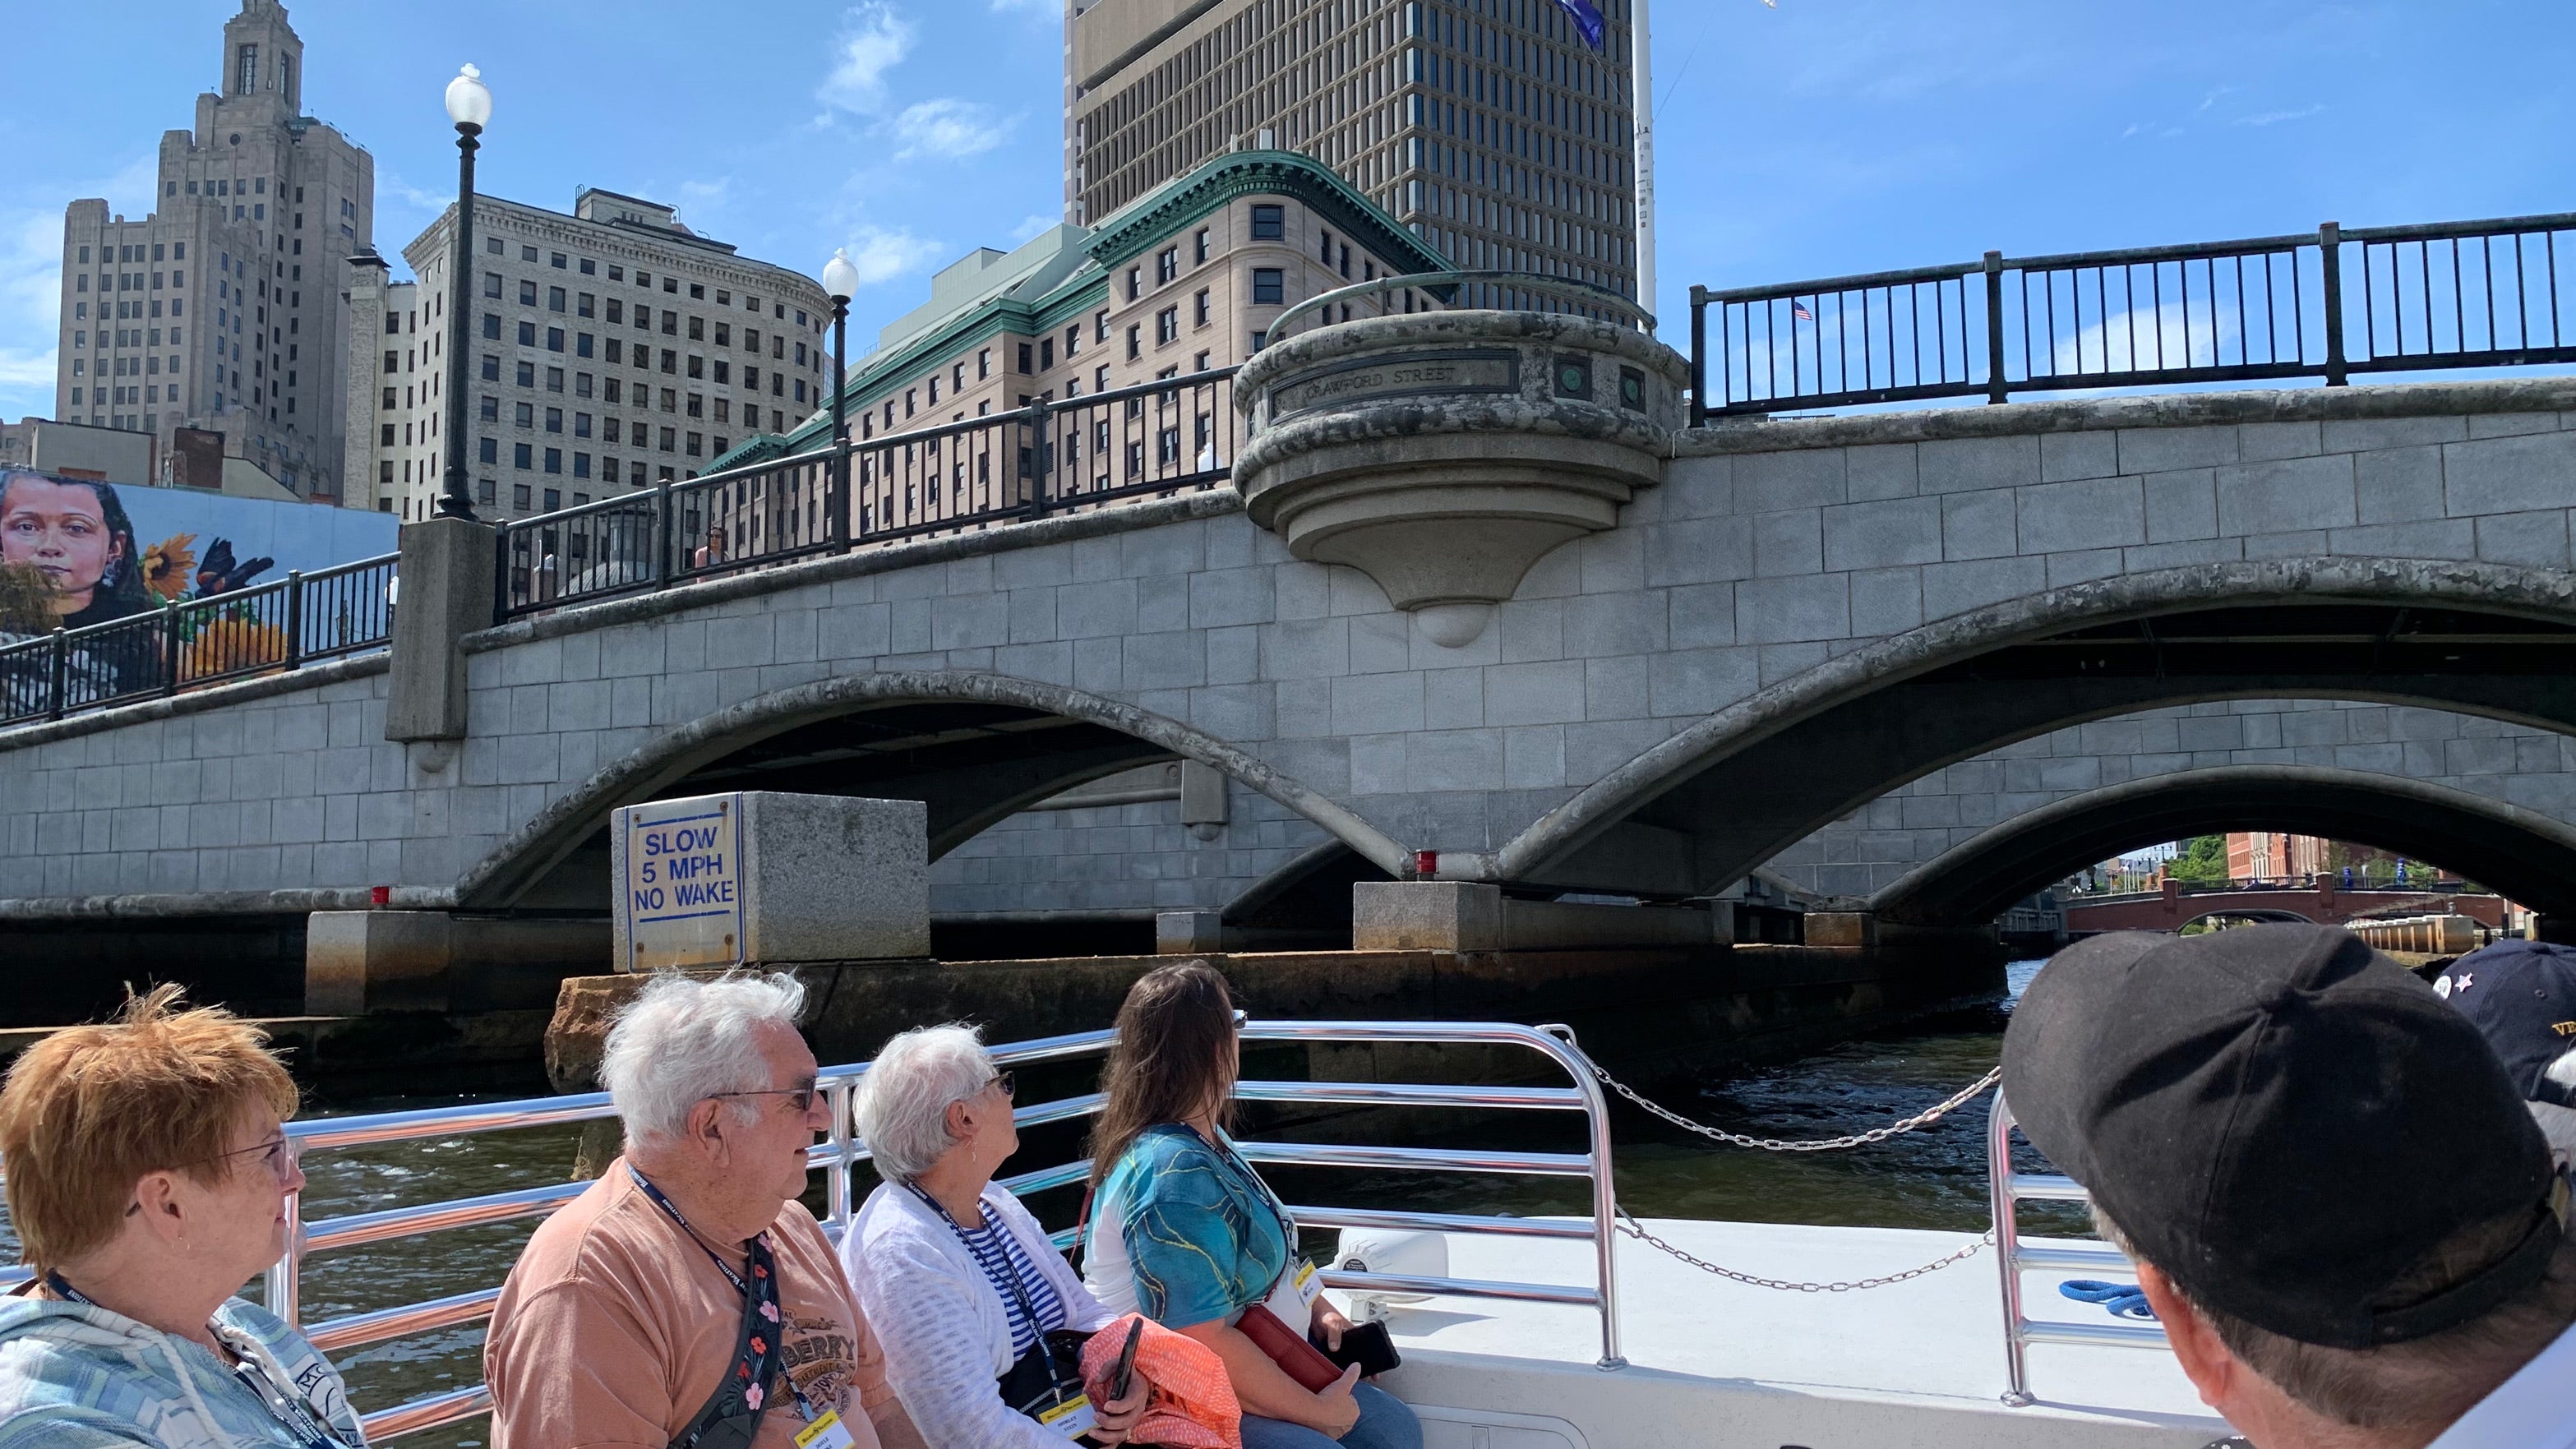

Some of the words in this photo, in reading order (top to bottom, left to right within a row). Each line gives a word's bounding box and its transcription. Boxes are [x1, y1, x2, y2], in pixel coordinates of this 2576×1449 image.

[1306, 374, 1383, 399] CRAWFORD
[1393, 367, 1456, 384] STREET
[645, 826, 718, 856] SLOW
[642, 861, 657, 884] 5
[669, 853, 722, 880] MPH
[635, 888, 665, 911] NO
[674, 880, 734, 907] WAKE
